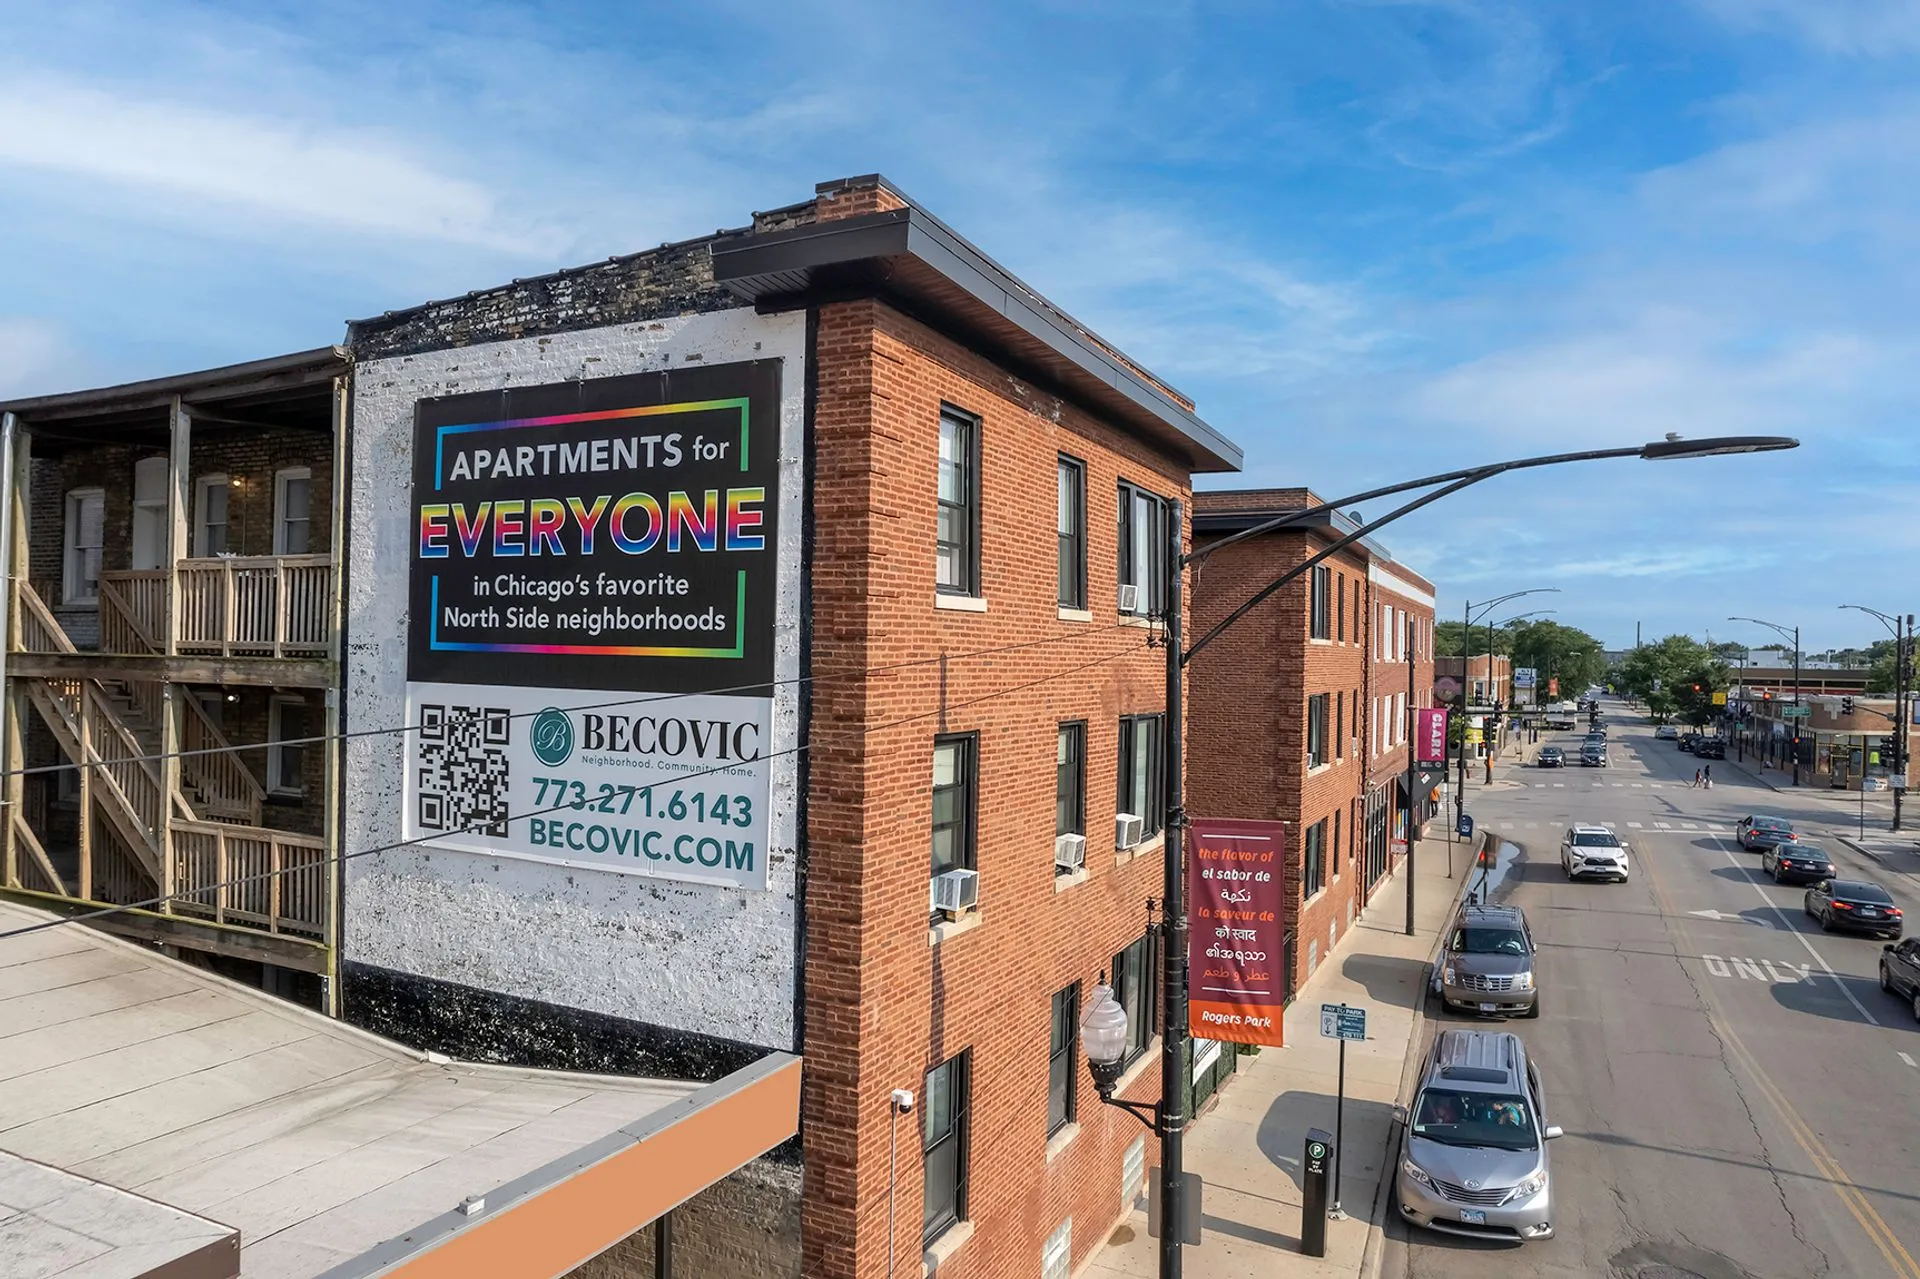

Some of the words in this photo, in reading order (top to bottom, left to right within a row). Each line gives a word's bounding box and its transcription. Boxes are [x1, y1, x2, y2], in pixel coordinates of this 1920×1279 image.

[449, 432, 683, 481] APARTMENTS
[692, 435, 730, 460] for
[419, 487, 765, 558] EVERYONE
[473, 575, 490, 596] in
[494, 574, 590, 602] Chicago's
[596, 572, 689, 595] favorite
[444, 606, 500, 628] North
[506, 606, 550, 629] Side
[556, 606, 726, 635] neighborhoods
[581, 713, 759, 762] BECOVIC
[1431, 713, 1443, 757] CLARK
[582, 755, 654, 769] Neighborhood.
[657, 760, 719, 776] Community.
[722, 766, 757, 778] Home.
[532, 777, 753, 828] 773.271.6143
[530, 818, 754, 872] BECOVIC.COM
[1198, 848, 1219, 860] the
[1221, 848, 1258, 862] flavor
[1260, 851, 1274, 862] of
[1202, 868, 1214, 879] el
[1216, 869, 1252, 881] sabor
[1255, 871, 1271, 882] de
[1221, 888, 1251, 903] نكهة
[1198, 907, 1210, 918] la
[1213, 909, 1256, 921] saveur
[1259, 910, 1275, 922] de
[1702, 953, 1817, 987] ONLY
[1202, 1010, 1242, 1025] Rogers
[1244, 1015, 1272, 1028] Park
[1345, 1009, 1363, 1017] PARK
